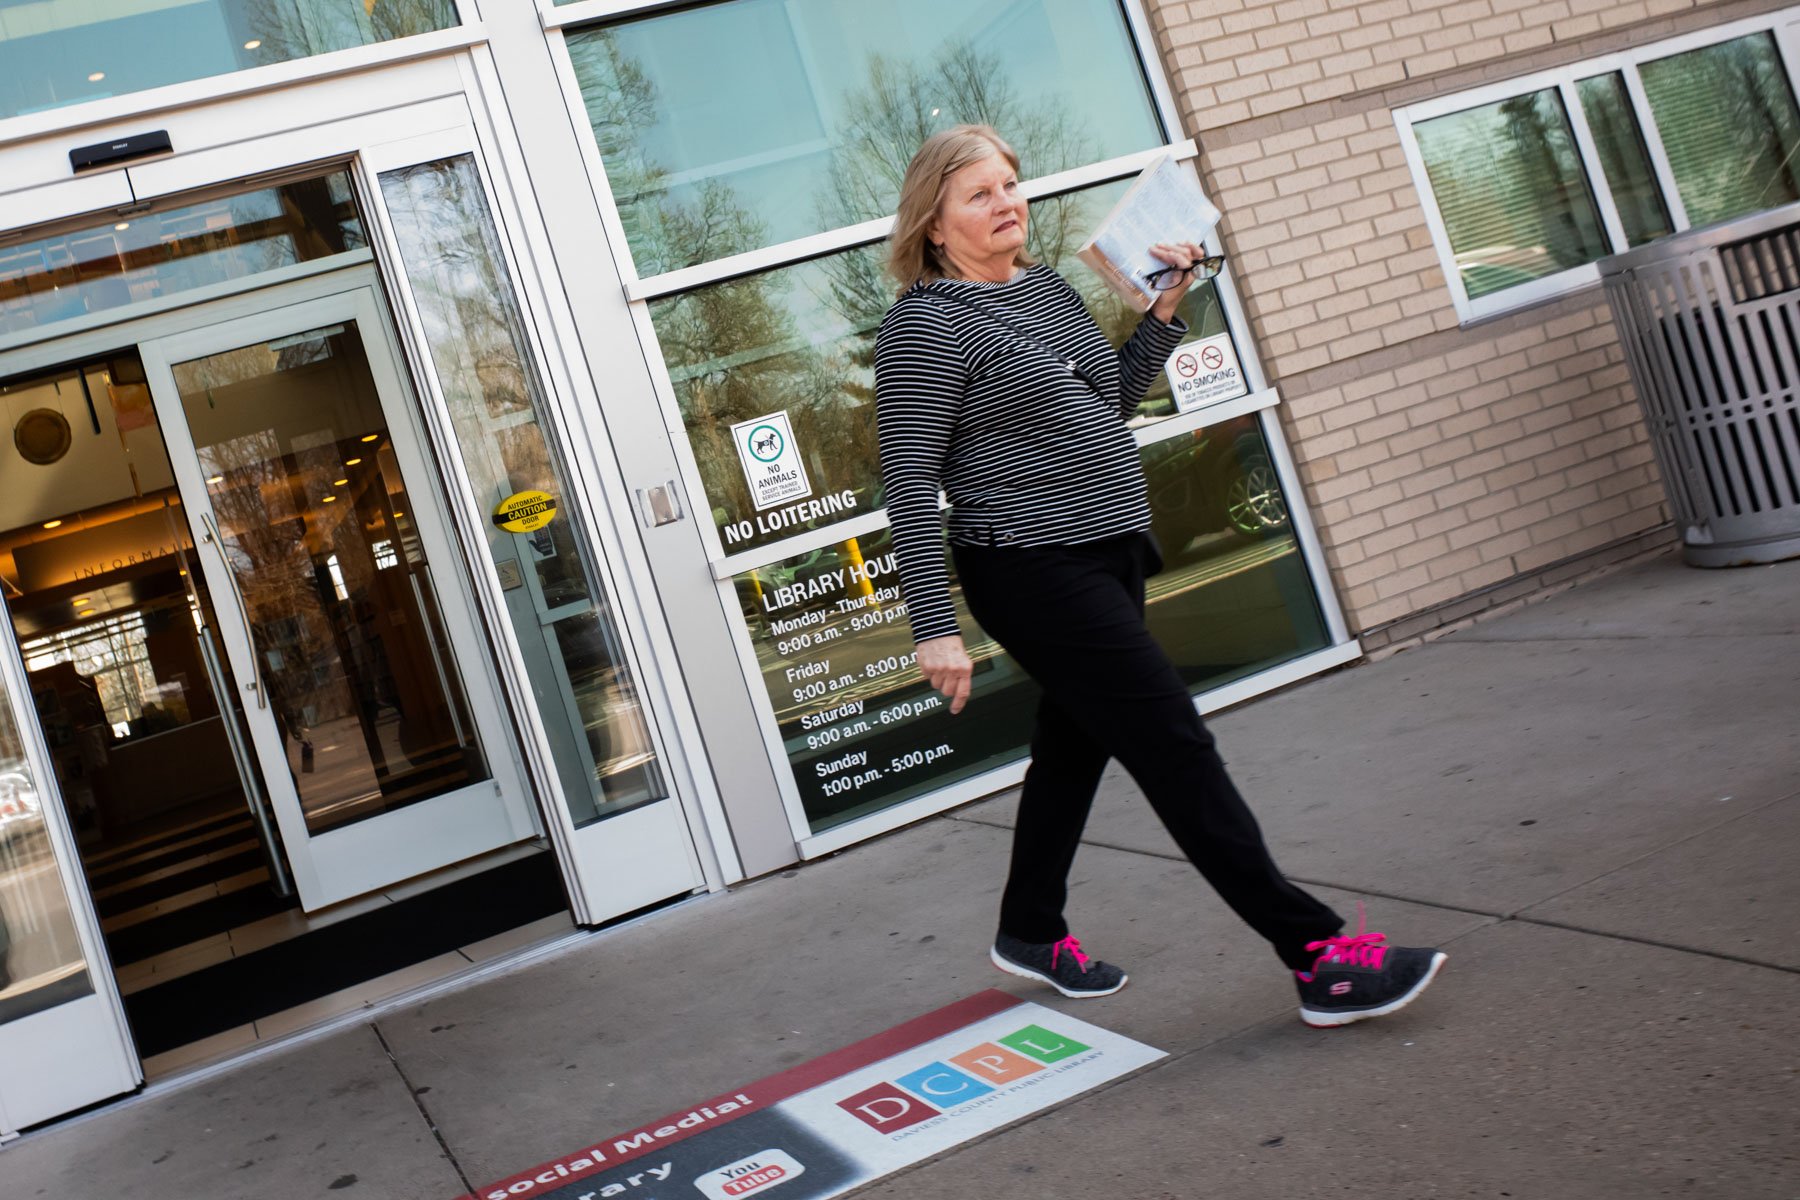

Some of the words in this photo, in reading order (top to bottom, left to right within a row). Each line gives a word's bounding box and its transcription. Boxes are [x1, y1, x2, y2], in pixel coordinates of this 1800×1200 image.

[1177, 381, 1193, 393] NO
[1193, 368, 1236, 388] SMOKING
[758, 470, 798, 489] ANIMALS
[767, 463, 781, 475] NO
[508, 495, 542, 510] AUTOMATIC
[781, 485, 802, 495] ANIMALS
[508, 502, 547, 520] CAUTION
[522, 515, 540, 525] DOOR
[724, 520, 754, 544] NO
[757, 489, 857, 534] LOITERING
[761, 568, 845, 612] LIBRARY
[771, 608, 827, 636] Monday
[836, 584, 901, 615] Thursday
[778, 634, 811, 655] 9:00
[813, 625, 843, 644] a.m.
[850, 610, 883, 632] 9:00
[785, 658, 831, 683] Friday
[793, 681, 826, 703] 9:00
[828, 672, 858, 691] a.m.
[865, 656, 898, 678] 8:00
[800, 700, 865, 730] Saturday
[807, 729, 840, 750] 9:00
[843, 719, 871, 739] a.m.
[880, 704, 912, 725] 6:00
[914, 695, 942, 718] p.m.
[815, 750, 868, 778] Sunday
[821, 776, 852, 797] 1:00
[854, 769, 883, 790] p.m.
[891, 751, 924, 773] 5:00
[925, 742, 954, 766] p.m.
[891, 1116, 948, 1142] DAVIESS
[949, 1088, 1010, 1117] COUNTY
[1008, 1070, 1056, 1093] PUBLIC
[1056, 1051, 1105, 1074] LIBRARY
[487, 1149, 607, 1200] social
[613, 1093, 754, 1155] Media!
[578, 1161, 672, 1200] rary
[719, 1162, 761, 1179] You
[725, 1168, 782, 1192] Tube
